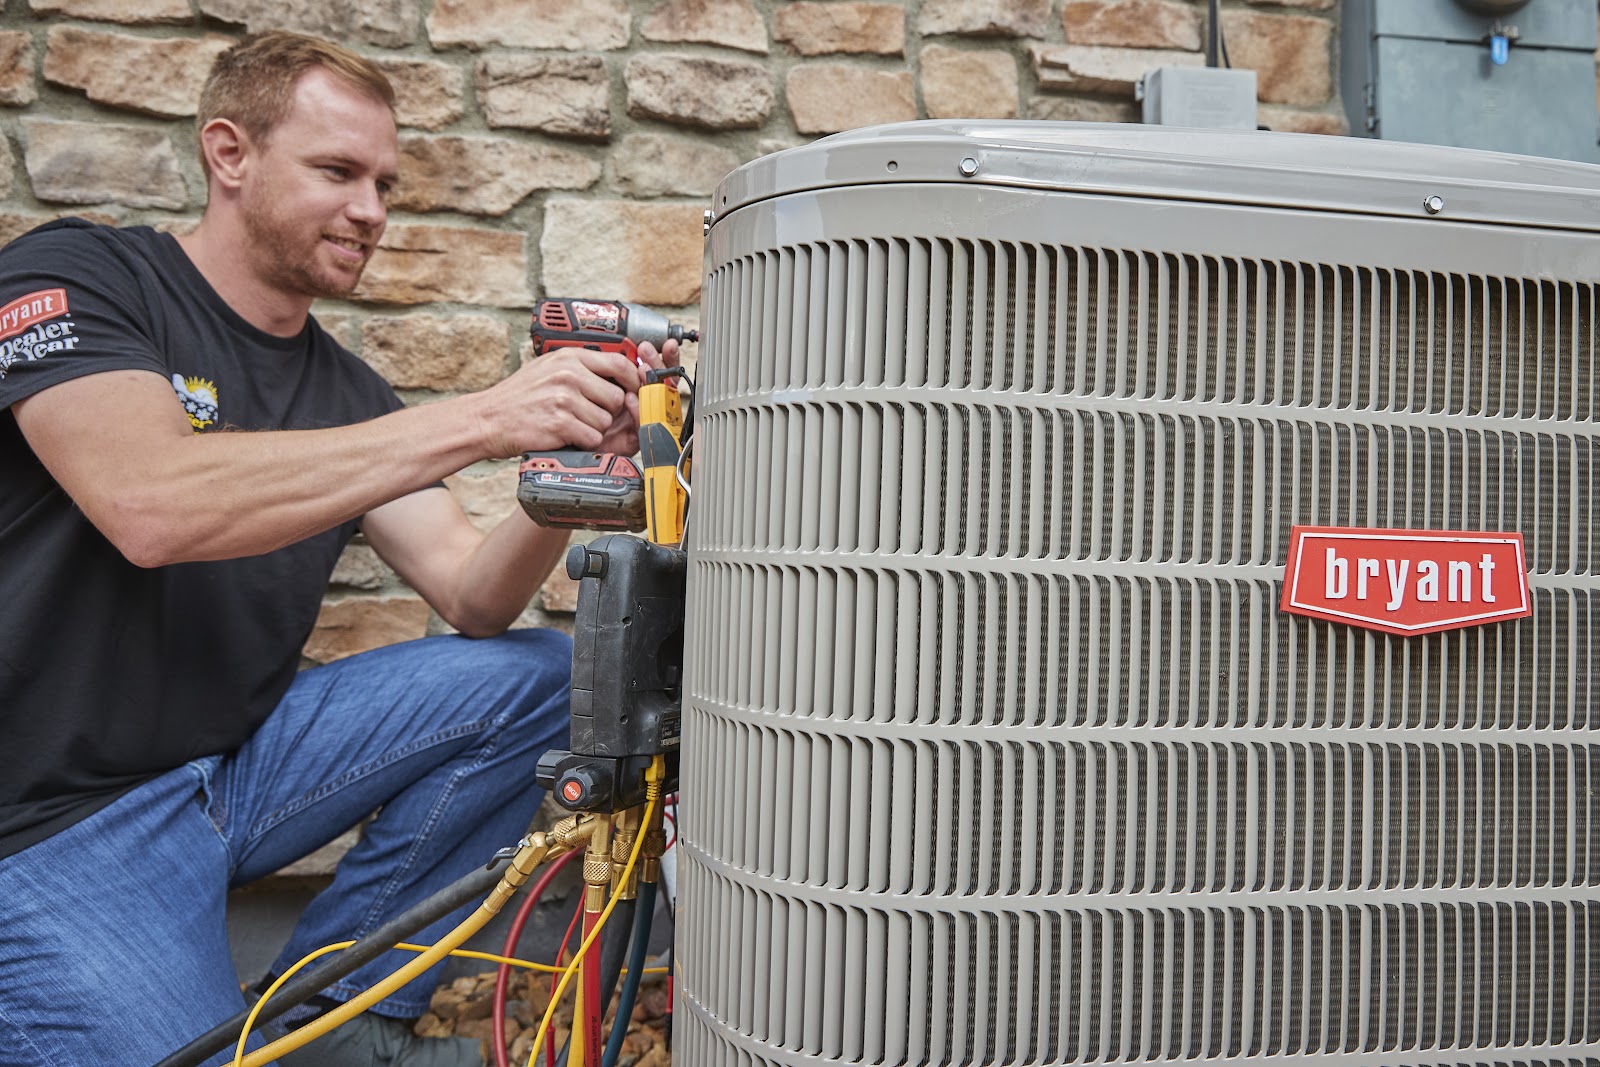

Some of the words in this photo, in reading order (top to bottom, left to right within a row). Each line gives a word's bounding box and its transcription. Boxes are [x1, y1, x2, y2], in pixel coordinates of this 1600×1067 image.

[0, 296, 53, 331] ryant
[22, 337, 79, 361] Year
[1325, 547, 1496, 612] bryant
[565, 784, 579, 799] HIGH
